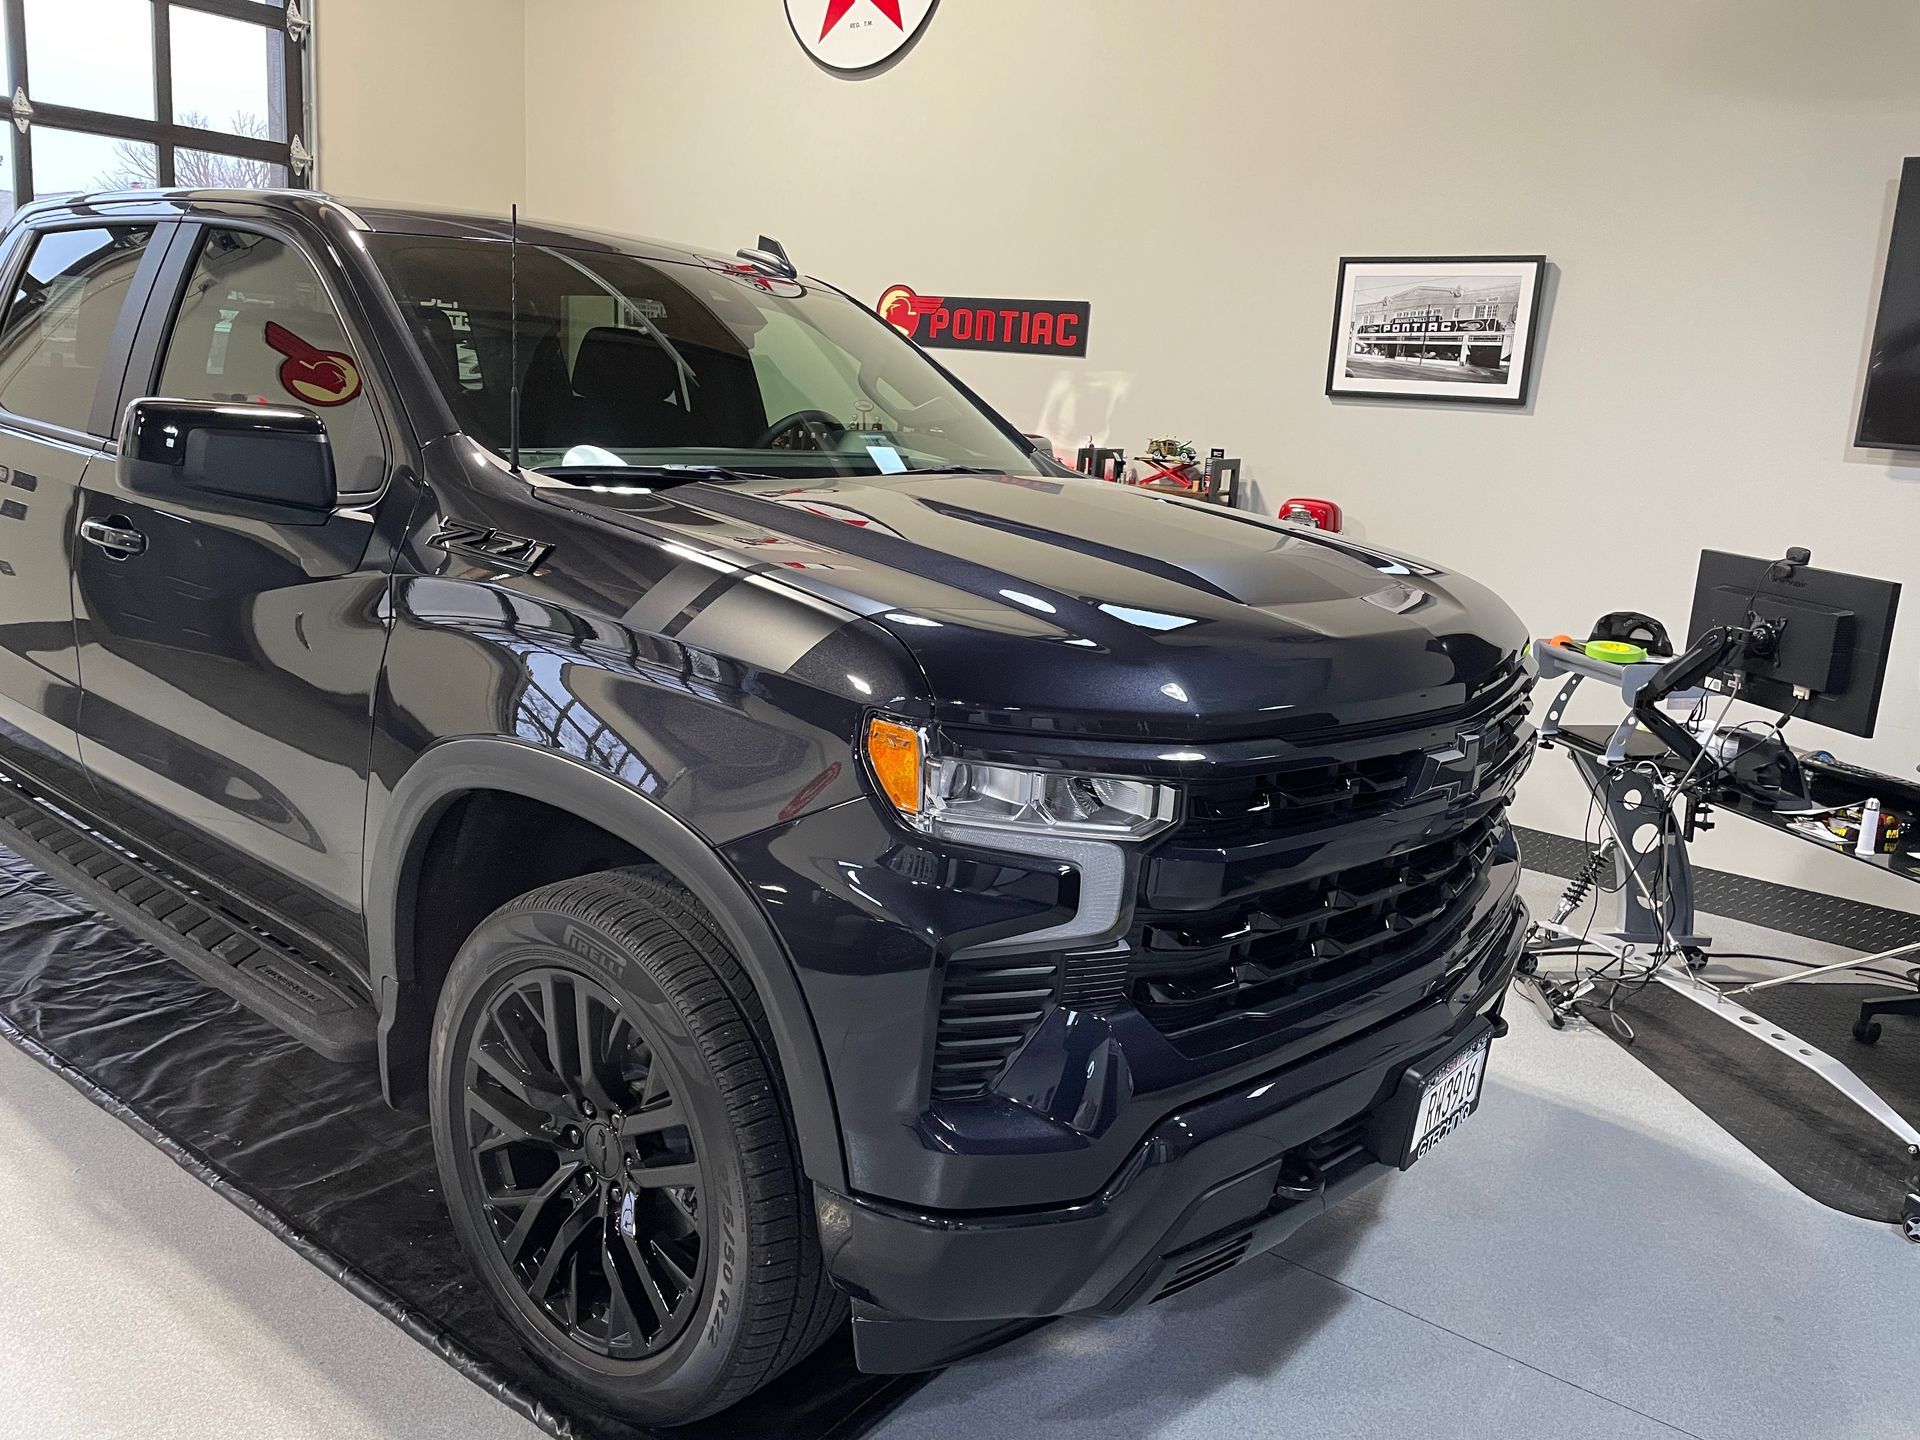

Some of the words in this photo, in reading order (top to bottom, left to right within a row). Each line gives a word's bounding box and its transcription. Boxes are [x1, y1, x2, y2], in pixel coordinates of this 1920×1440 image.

[929, 307, 1080, 347] PONTIAC
[1383, 319, 1452, 333] PONTIAC
[425, 515, 555, 574] Z71
[562, 923, 628, 980] PIRELLI
